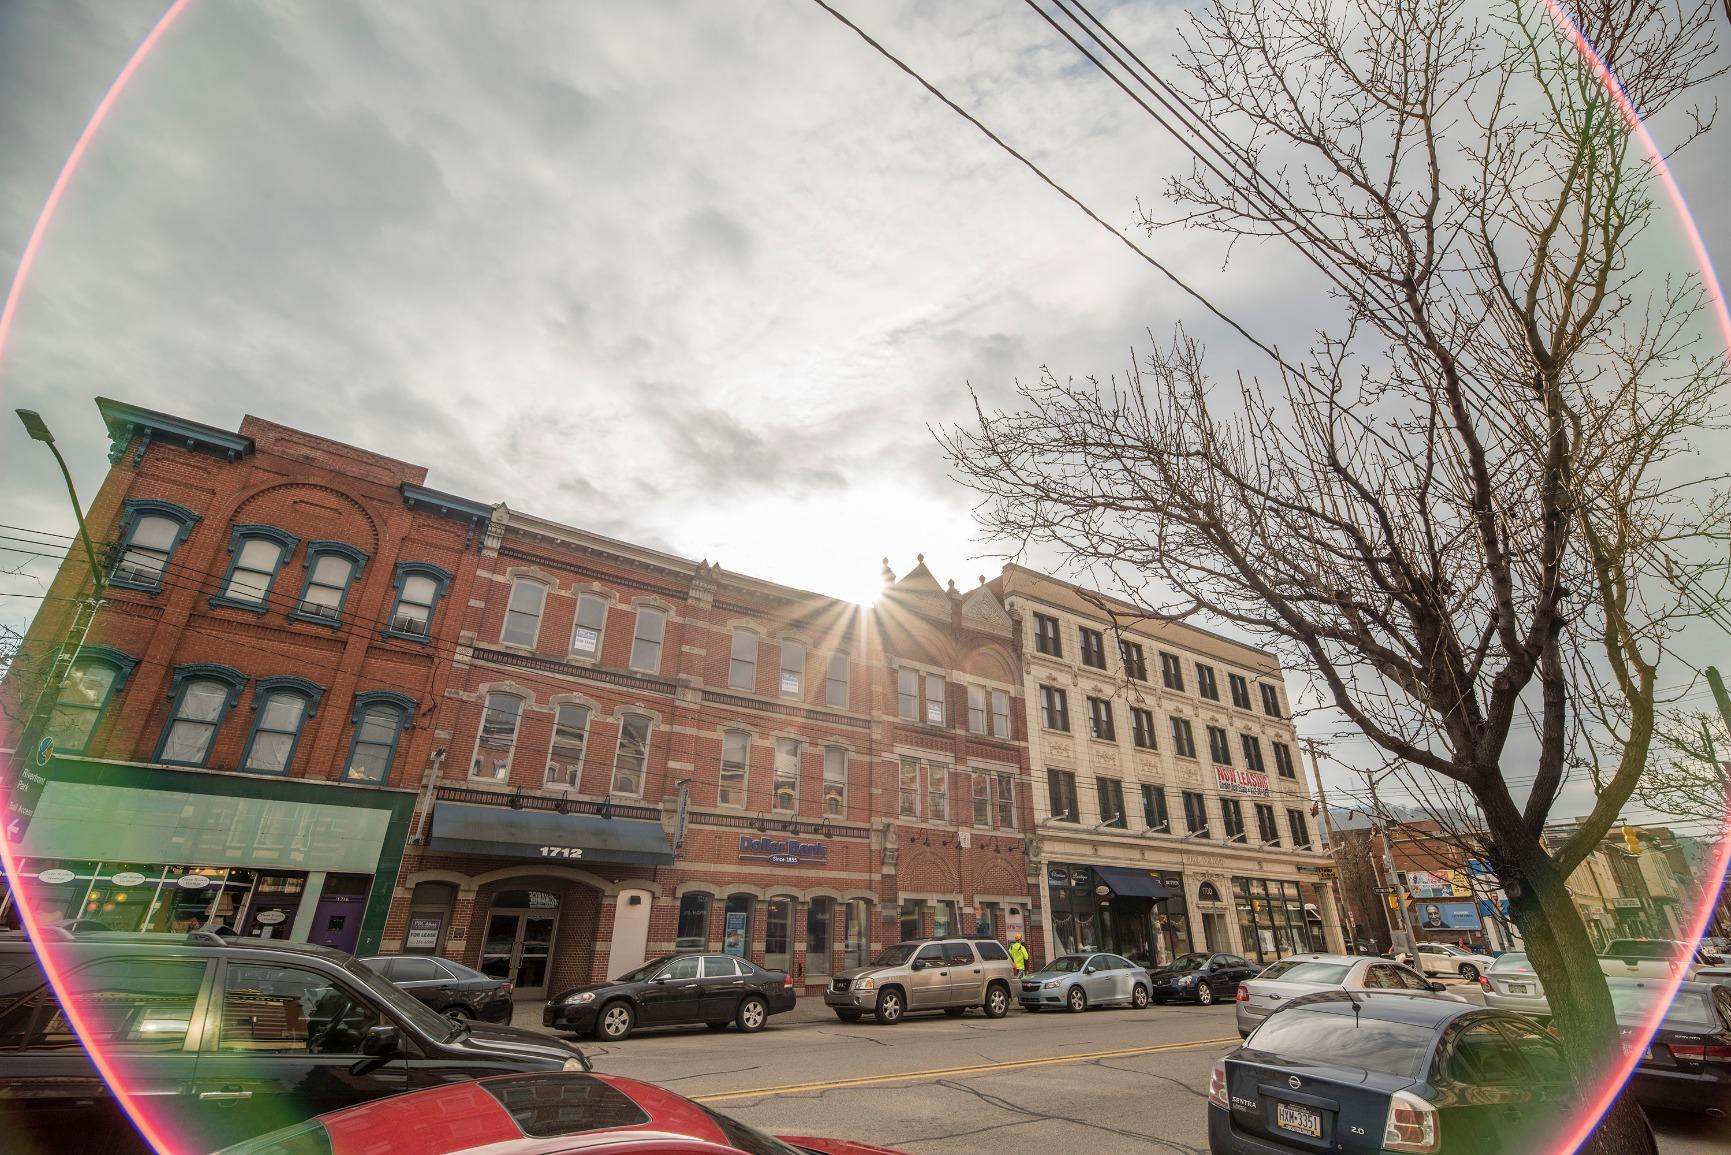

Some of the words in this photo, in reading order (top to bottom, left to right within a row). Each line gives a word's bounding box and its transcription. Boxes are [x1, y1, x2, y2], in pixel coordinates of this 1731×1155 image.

[22, 768, 47, 786] Riverfront
[1215, 766, 1237, 784] NOW
[1236, 769, 1269, 789] LEASING
[17, 779, 29, 792] Park
[540, 846, 583, 859] 1712
[739, 835, 786, 853] Dollar
[787, 839, 828, 857] Bank
[1231, 1096, 1257, 1109] SENTRA
[1351, 1126, 1365, 1135] 2.0
